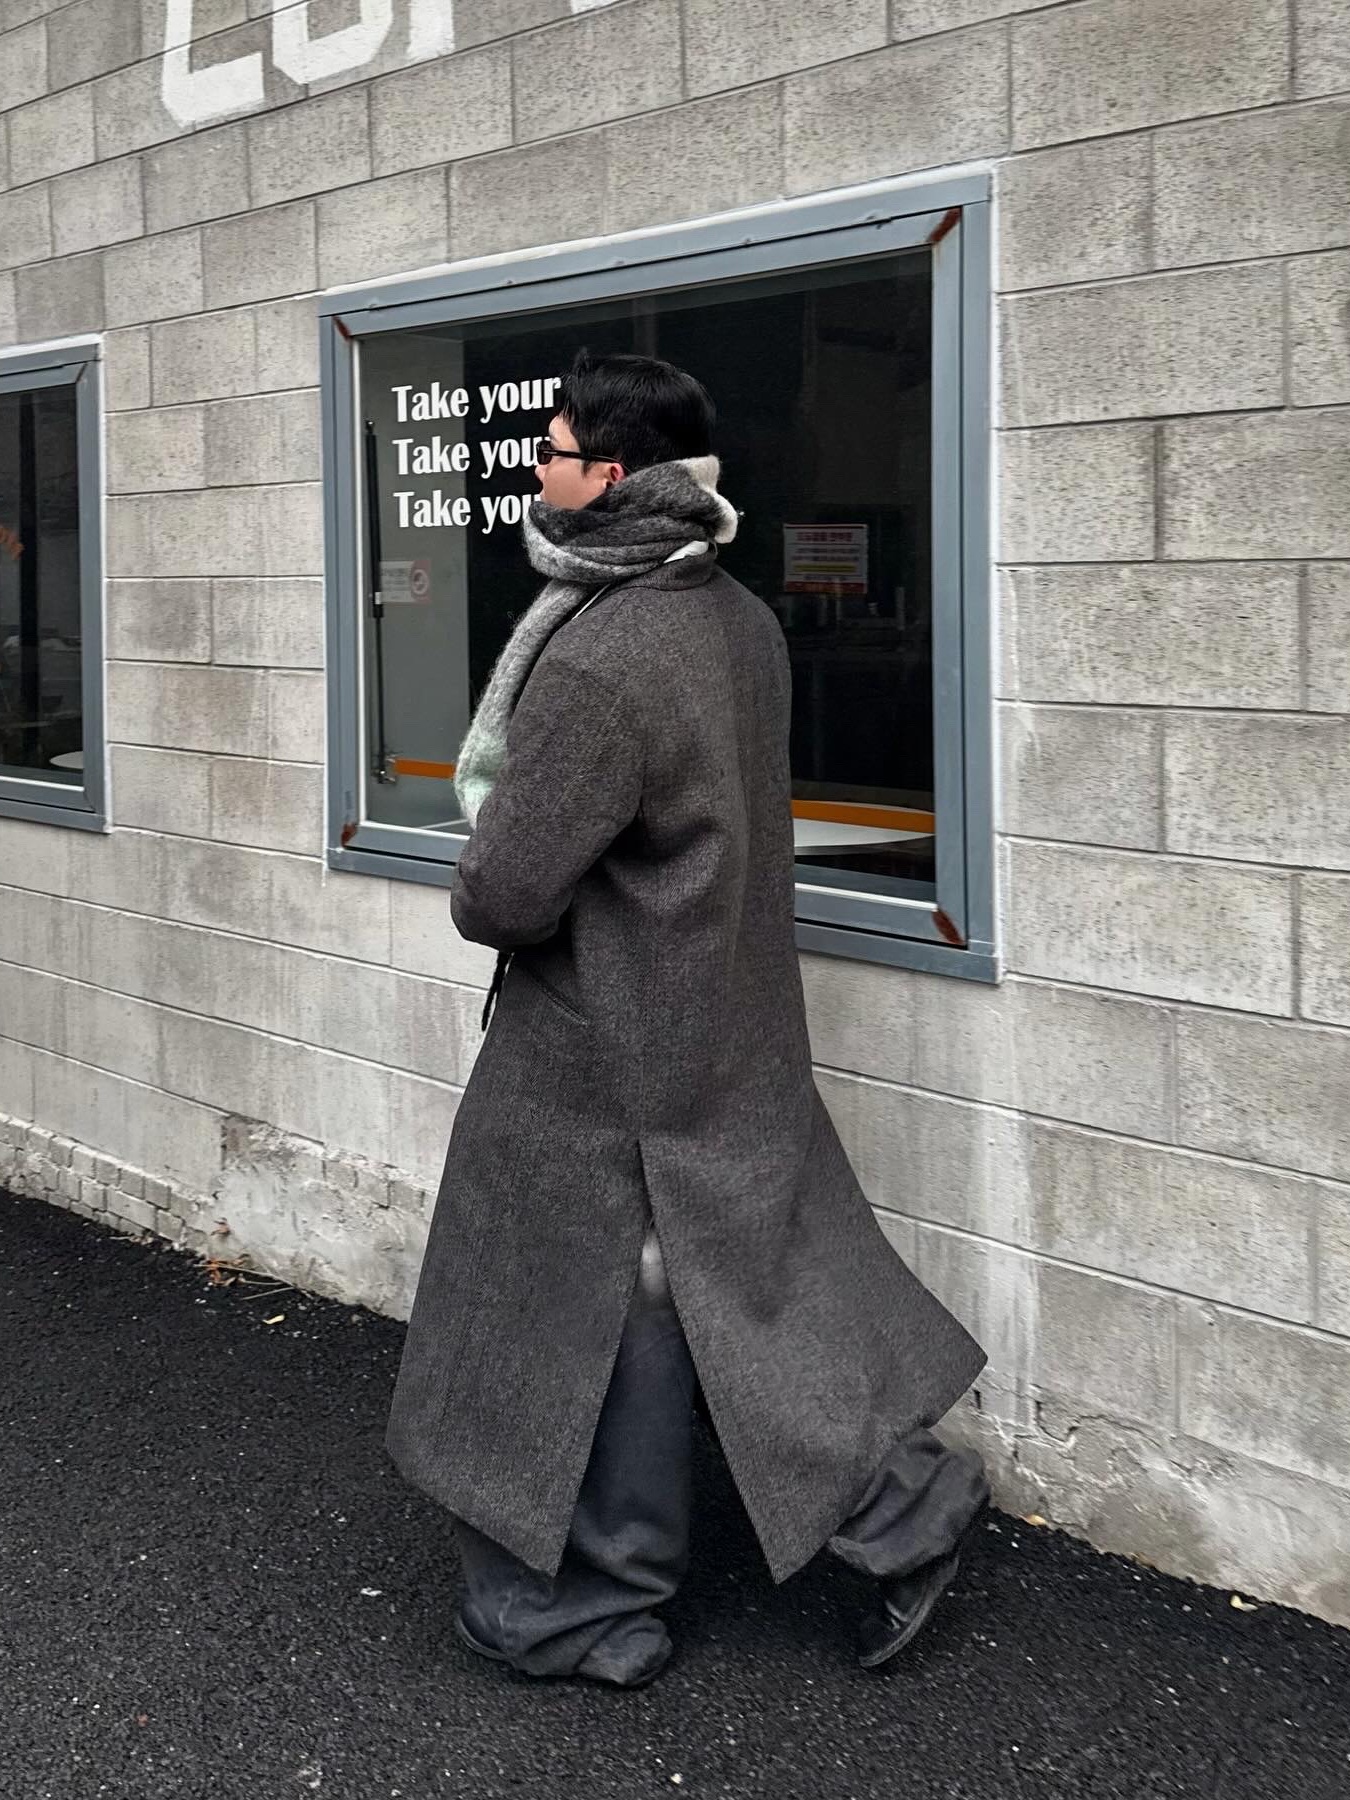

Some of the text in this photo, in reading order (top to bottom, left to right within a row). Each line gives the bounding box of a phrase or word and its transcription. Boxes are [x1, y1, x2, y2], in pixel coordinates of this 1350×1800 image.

[391, 377, 561, 424] Take your
[392, 436, 550, 479] Take you
[393, 490, 471, 528] Take
